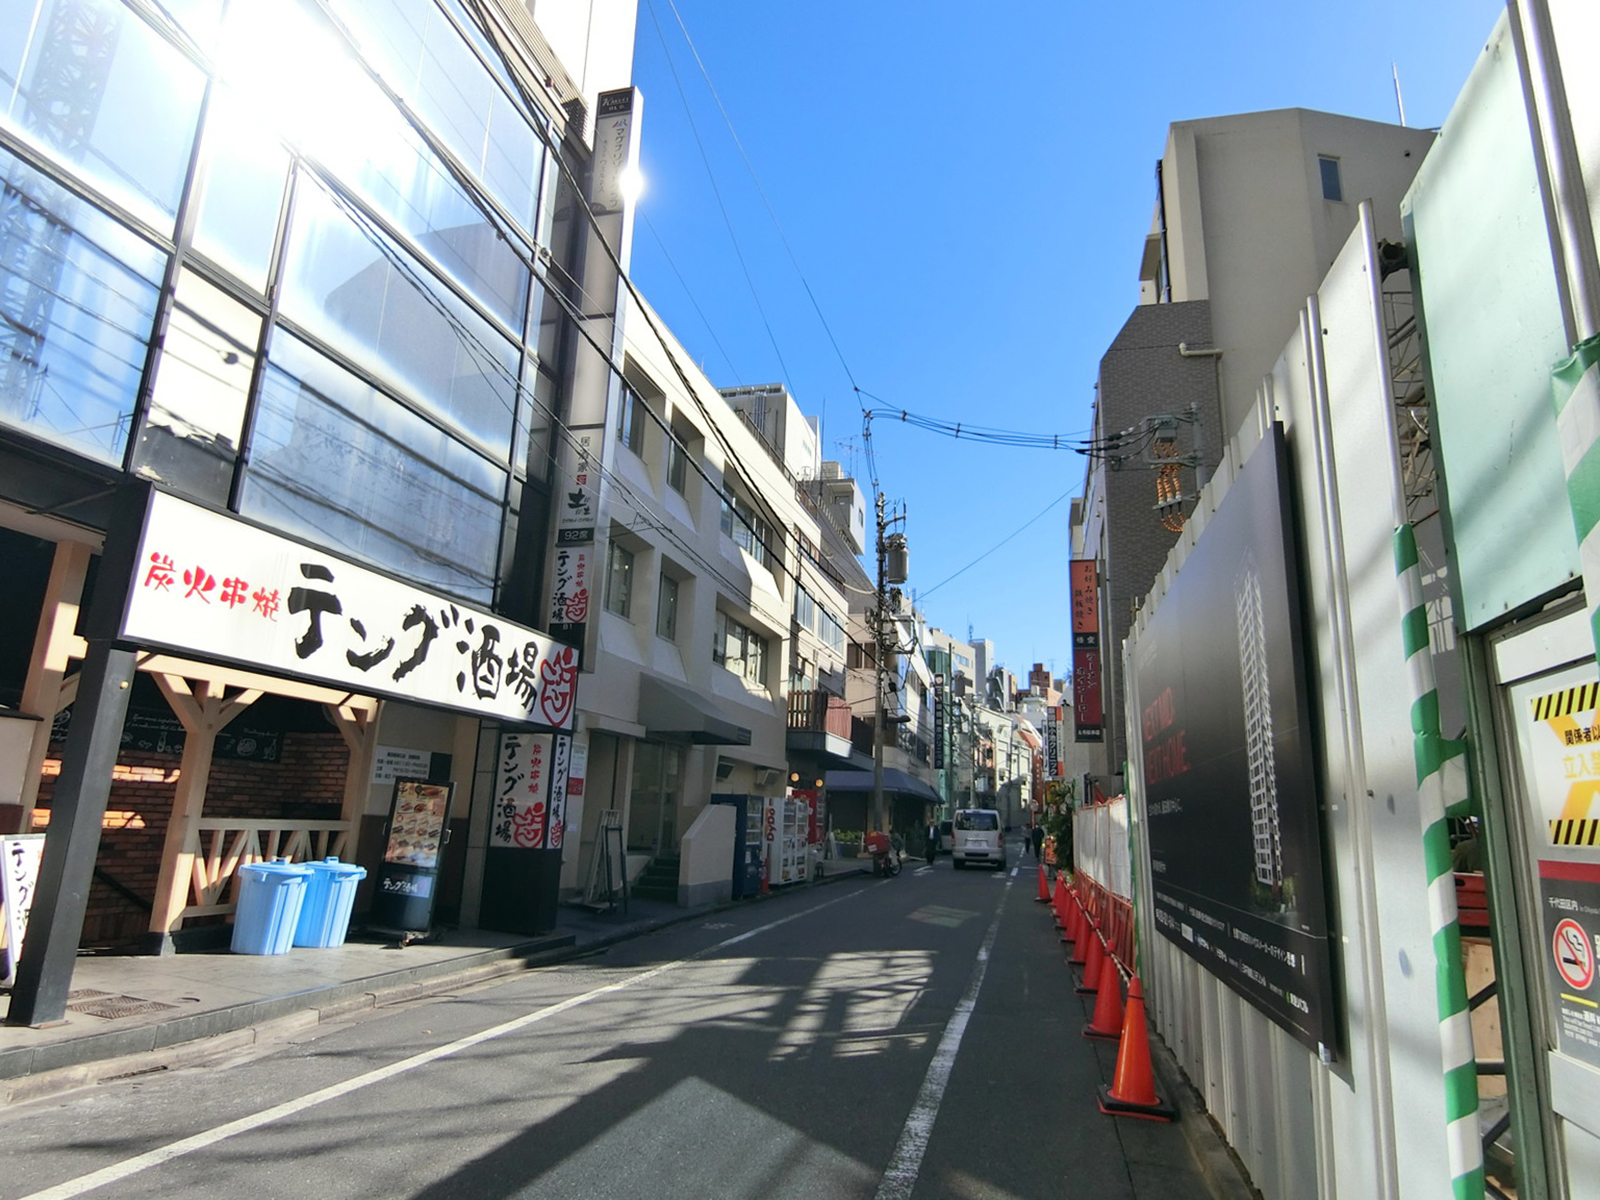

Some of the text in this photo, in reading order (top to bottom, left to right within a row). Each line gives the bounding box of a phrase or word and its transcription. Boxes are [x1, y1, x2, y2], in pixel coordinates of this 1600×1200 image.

[552, 551, 573, 622] テング酒場
[1084, 565, 1094, 615] お好み焼き
[144, 552, 538, 714] 炭火串焼 テング酒場
[495, 736, 525, 843] テング酒場
[528, 744, 542, 794] 炭火串焼
[552, 737, 568, 819] テング酒場
[766, 808, 777, 842] DyDo
